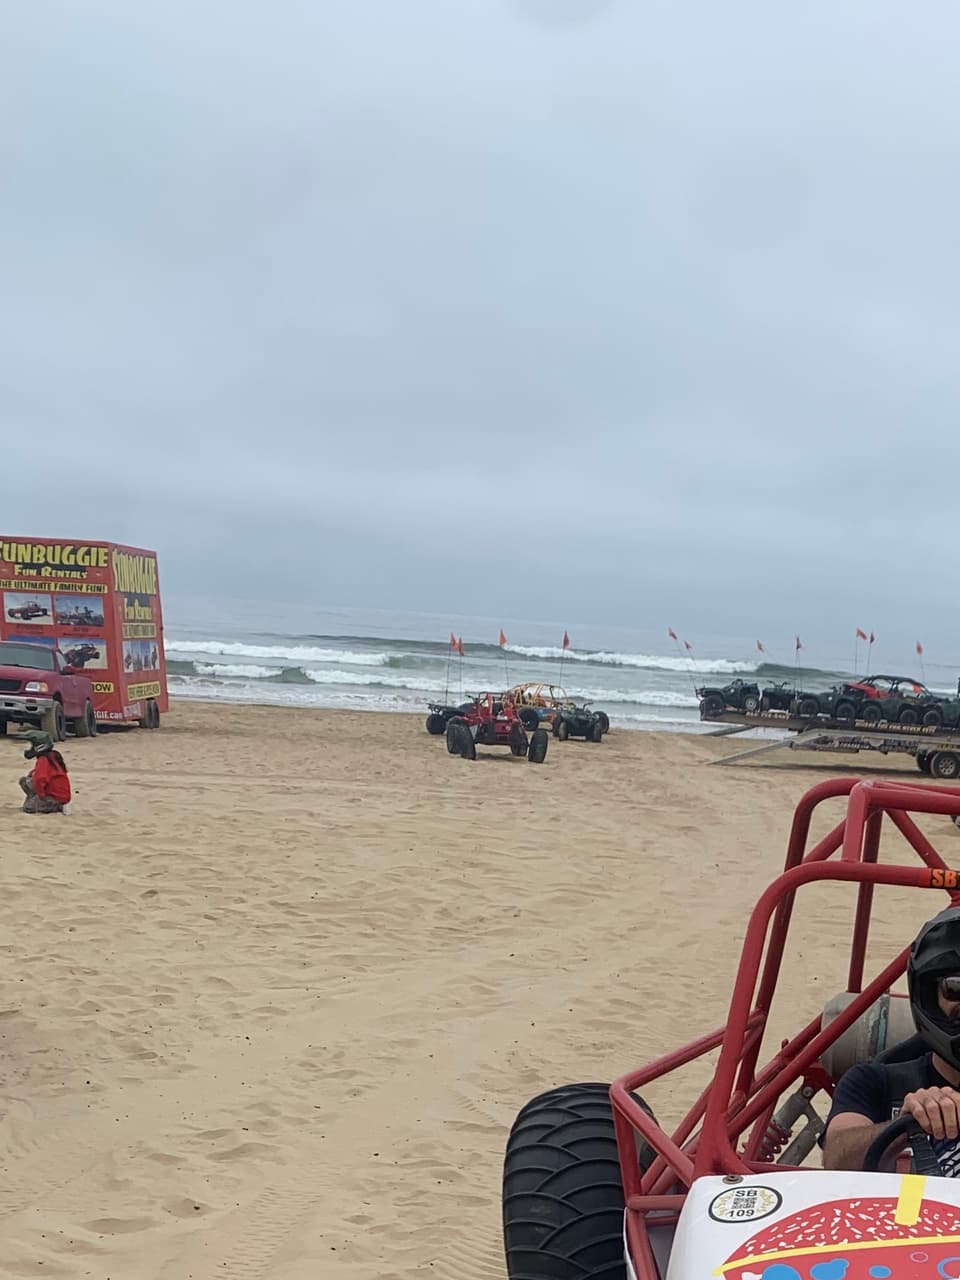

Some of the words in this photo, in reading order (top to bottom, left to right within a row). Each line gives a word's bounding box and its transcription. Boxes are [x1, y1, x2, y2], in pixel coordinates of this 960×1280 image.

[0, 580, 13, 588] HE
[735, 1189, 758, 1197] SB
[729, 1209, 755, 1217] 109
